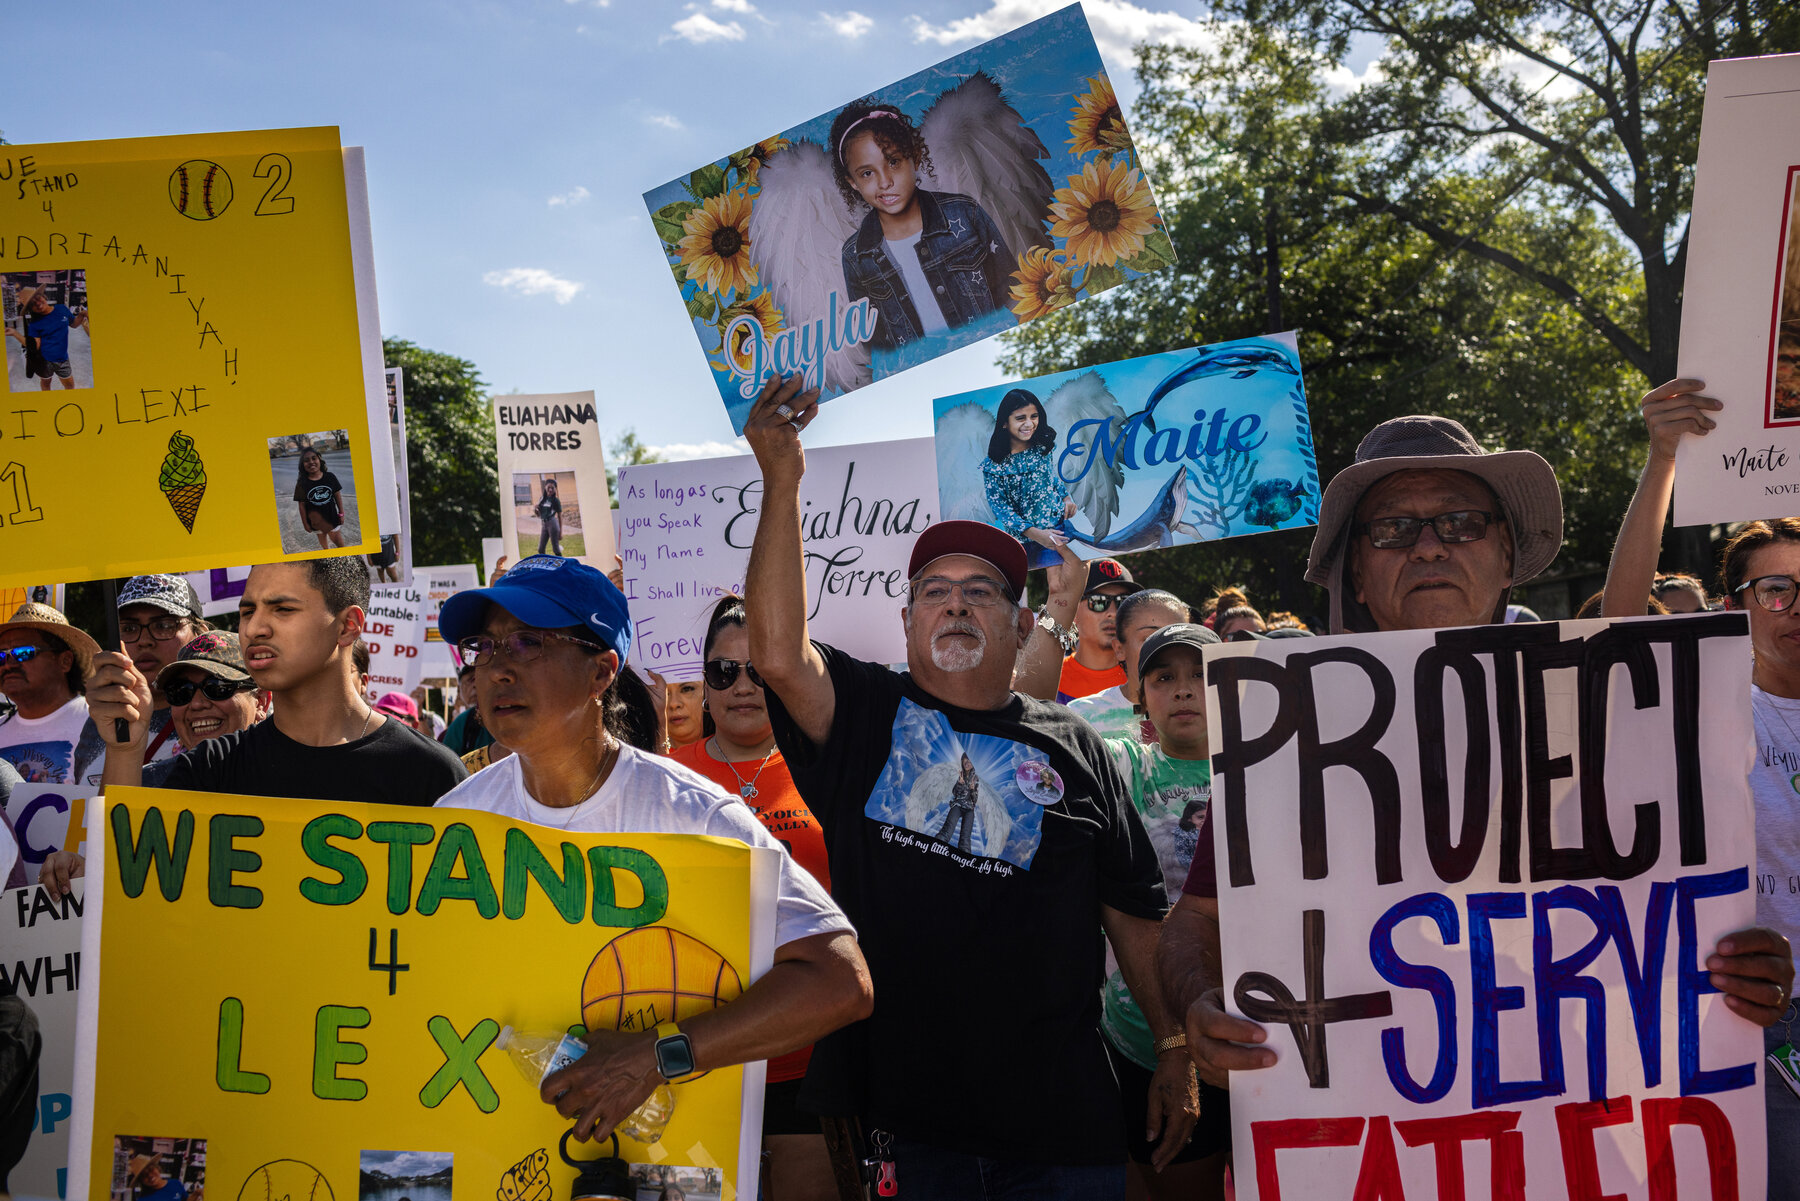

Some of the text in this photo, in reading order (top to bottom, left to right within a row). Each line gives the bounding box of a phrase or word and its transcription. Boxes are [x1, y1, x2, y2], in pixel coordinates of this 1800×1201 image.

[17, 172, 79, 200] STAND
[252, 152, 296, 218] 2
[42, 199, 55, 223] 4
[114, 384, 211, 425] LEXI
[499, 402, 599, 427] ELIAHANA
[507, 429, 582, 452] TORRES
[1057, 406, 1269, 484] Maite
[1722, 444, 1790, 478] Maite
[654, 479, 685, 507] long
[688, 484, 707, 498] as
[625, 516, 652, 537] you
[404, 589, 422, 603] Us
[625, 577, 640, 600] I
[647, 581, 685, 600] Shall
[693, 580, 723, 597] live
[393, 643, 419, 659] PD
[1206, 613, 1750, 888] PROTECT
[110, 802, 669, 928] WE STAND
[894, 830, 915, 848] high
[914, 839, 930, 854] my
[930, 841, 950, 858] little
[993, 860, 1014, 878] high
[368, 927, 411, 997] 4
[1368, 864, 1757, 1109] SERVE
[621, 1002, 665, 1032] #11
